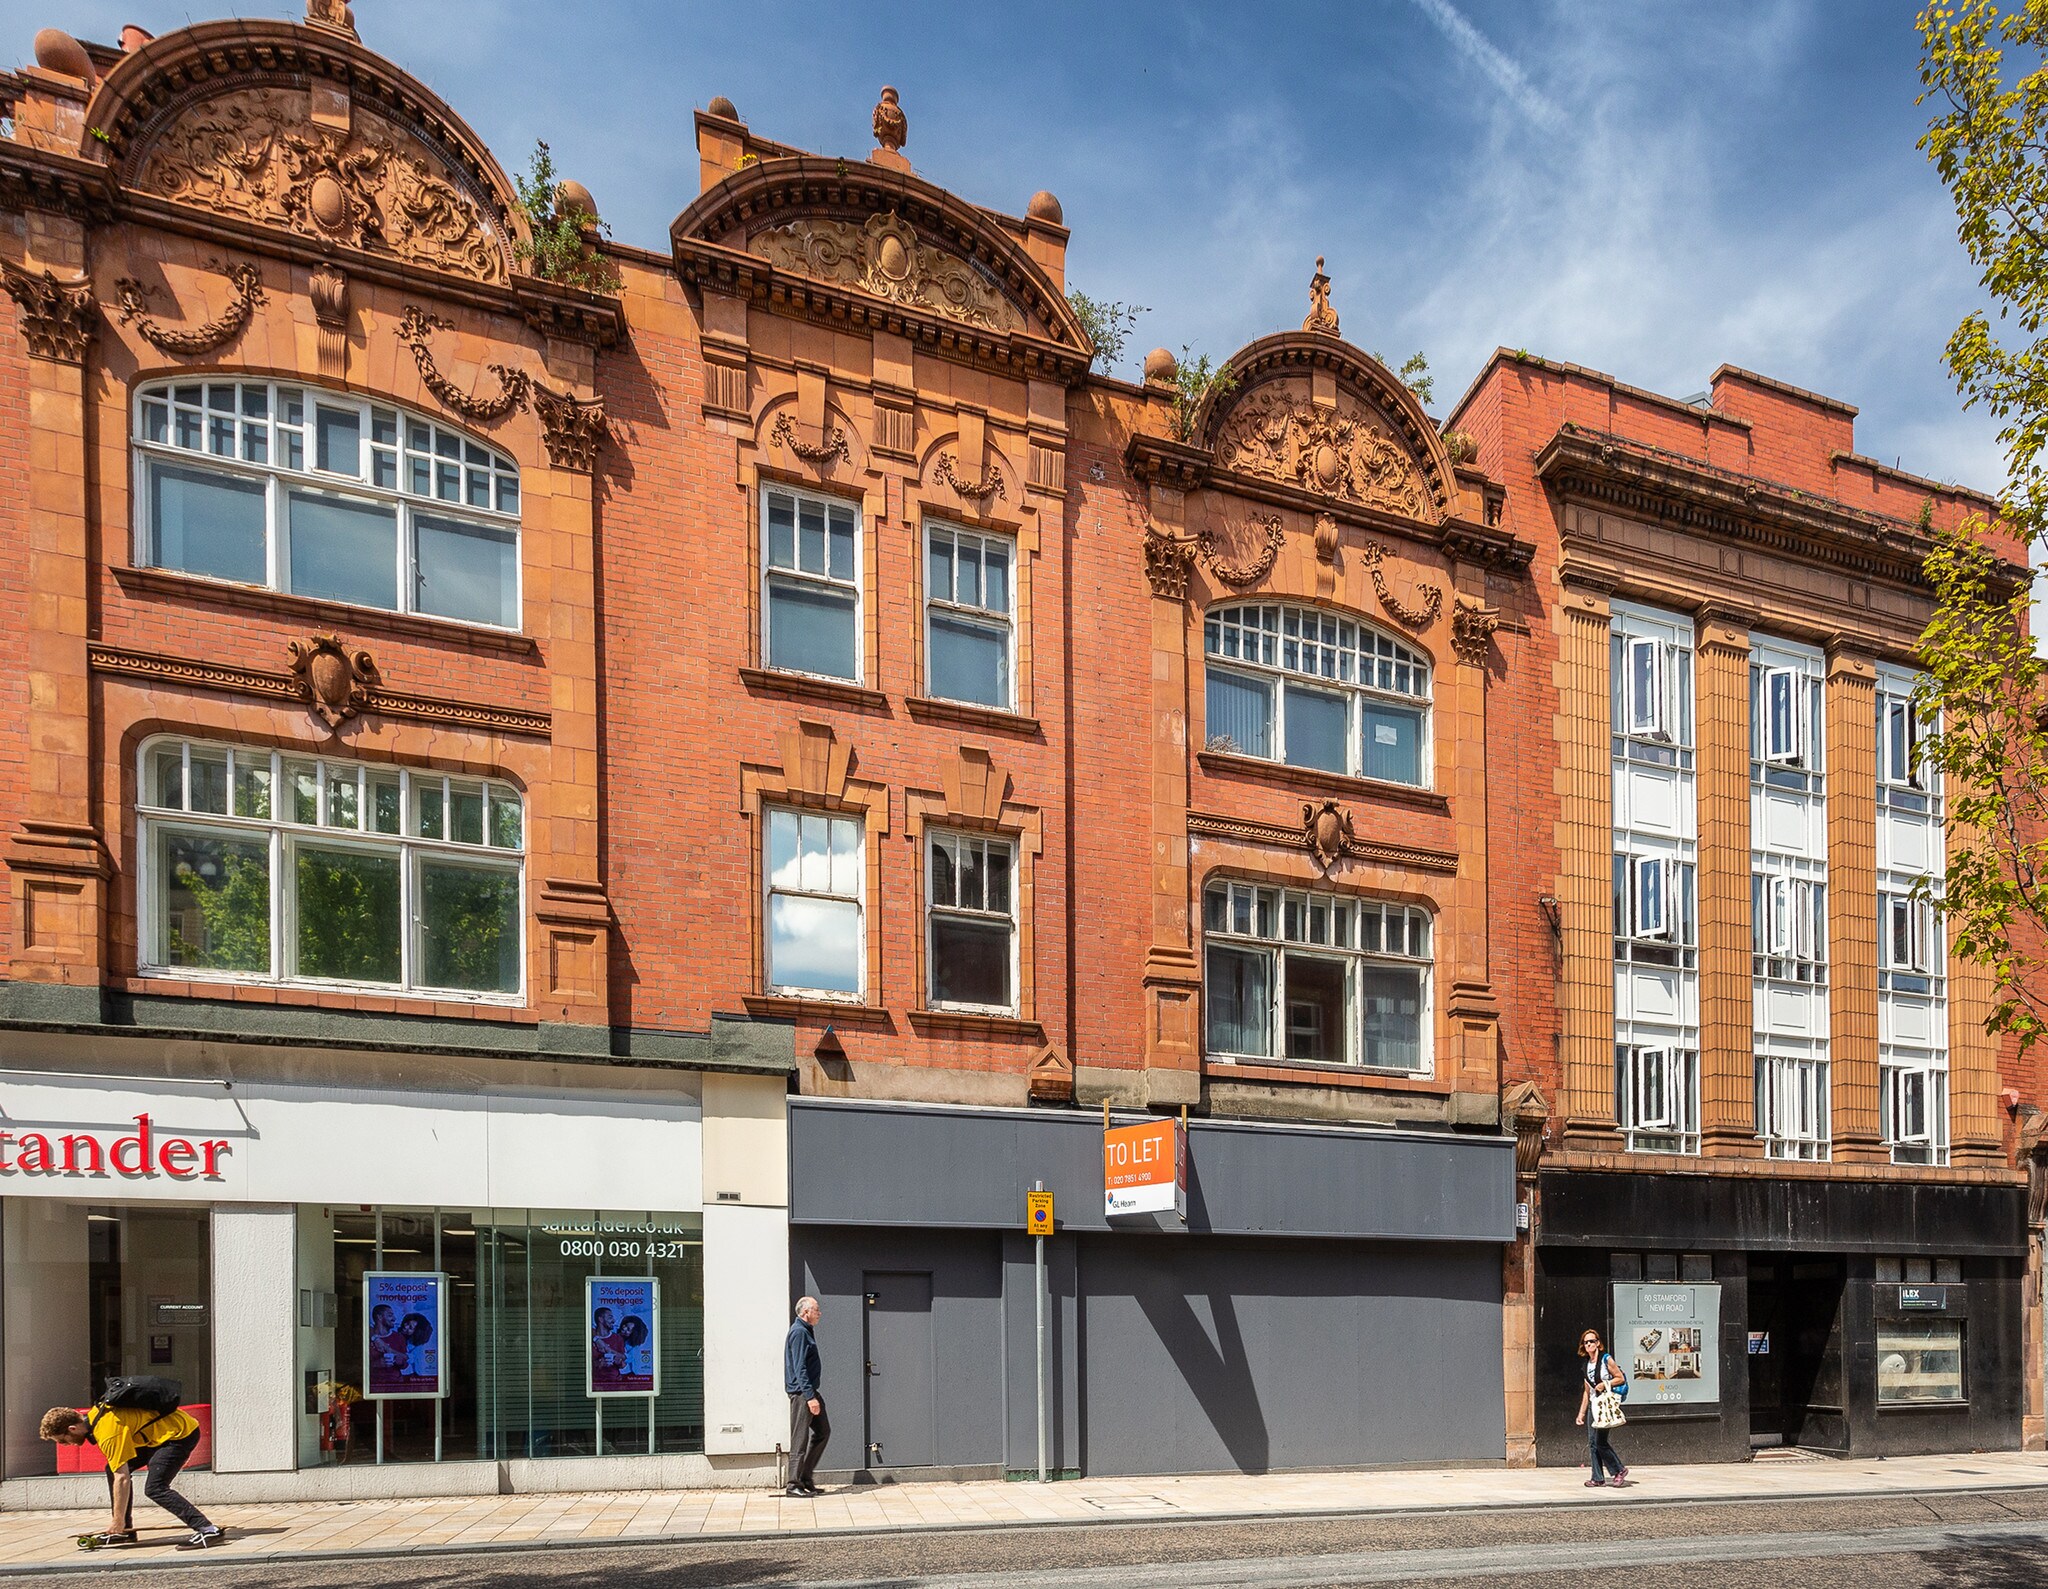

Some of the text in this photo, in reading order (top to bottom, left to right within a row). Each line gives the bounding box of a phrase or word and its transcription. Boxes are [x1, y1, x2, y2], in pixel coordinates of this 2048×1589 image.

[1106, 1142, 1127, 1167] TO
[1132, 1136, 1163, 1164] LET
[1107, 1172, 1152, 1185] T: 020 7851 4900
[1112, 1200, 1120, 1209] GL
[541, 1219, 684, 1235] santander.co.uk
[560, 1240, 684, 1259] 0800 030 4321
[379, 1283, 428, 1293] 5% deposit
[600, 1287, 645, 1296] 5% deposit
[379, 1294, 428, 1304] mortgages
[600, 1297, 644, 1306] mortgages
[1644, 1294, 1688, 1302] 60 STAMFORD
[1649, 1304, 1684, 1312] NEW ROAD
